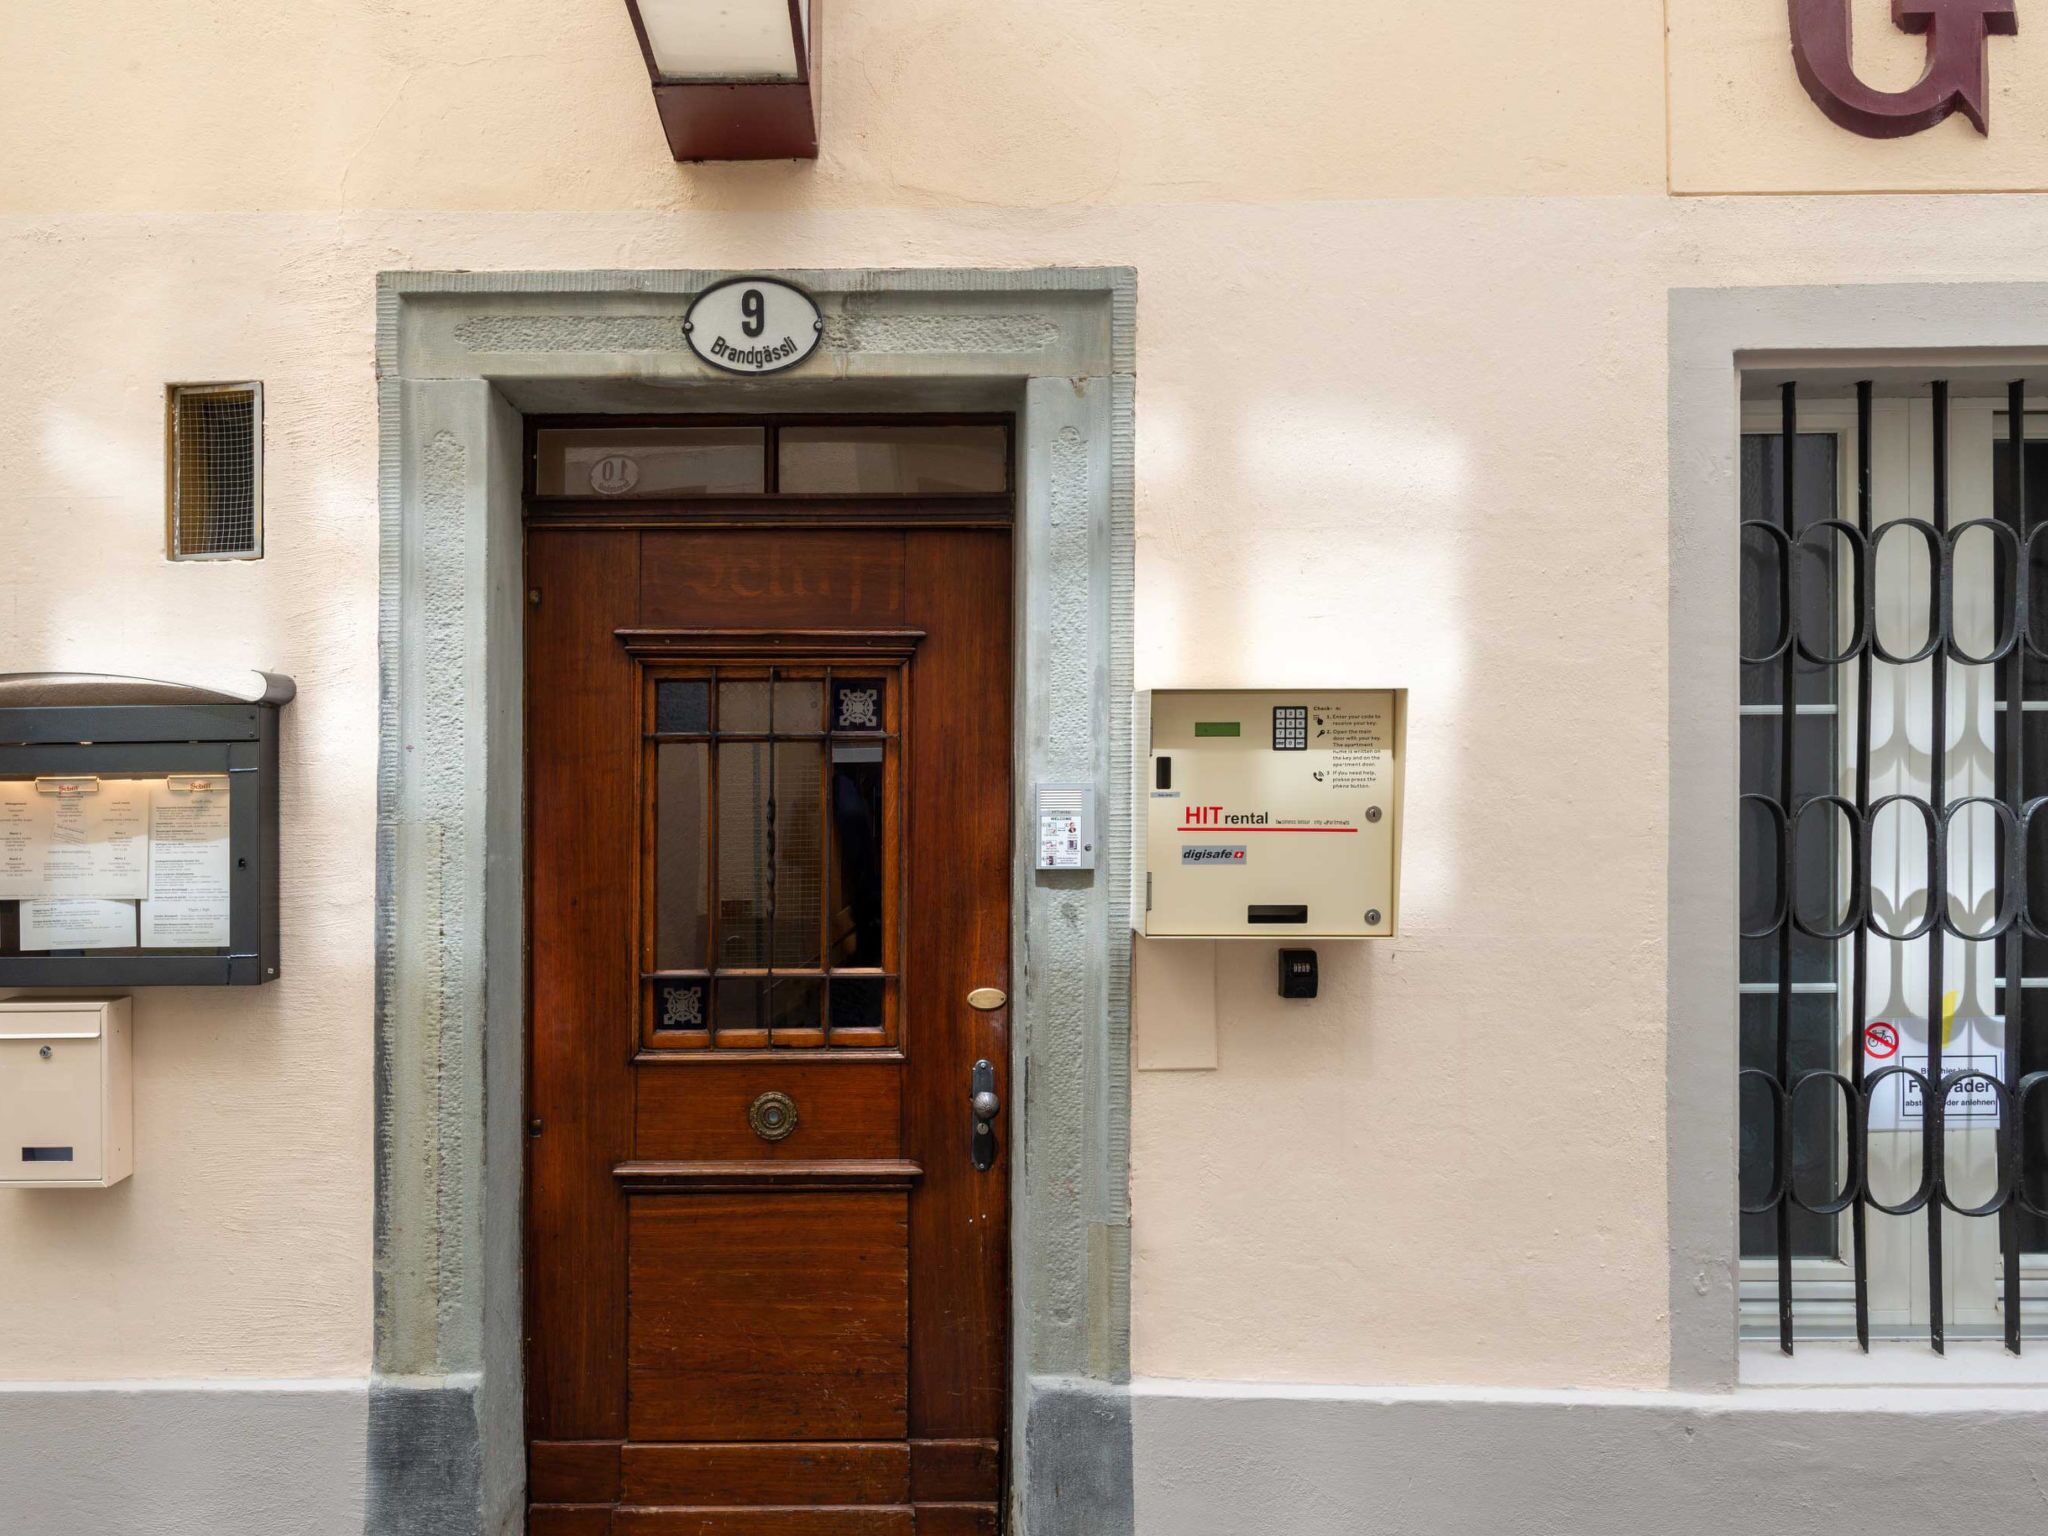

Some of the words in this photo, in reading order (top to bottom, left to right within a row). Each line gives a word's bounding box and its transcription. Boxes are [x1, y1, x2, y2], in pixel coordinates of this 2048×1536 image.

[741, 289, 765, 338] 9
[710, 335, 798, 368] Brandgässli
[1186, 806, 1223, 824] HIT
[1224, 812, 1268, 825] rental
[1183, 849, 1232, 861] digisafe
